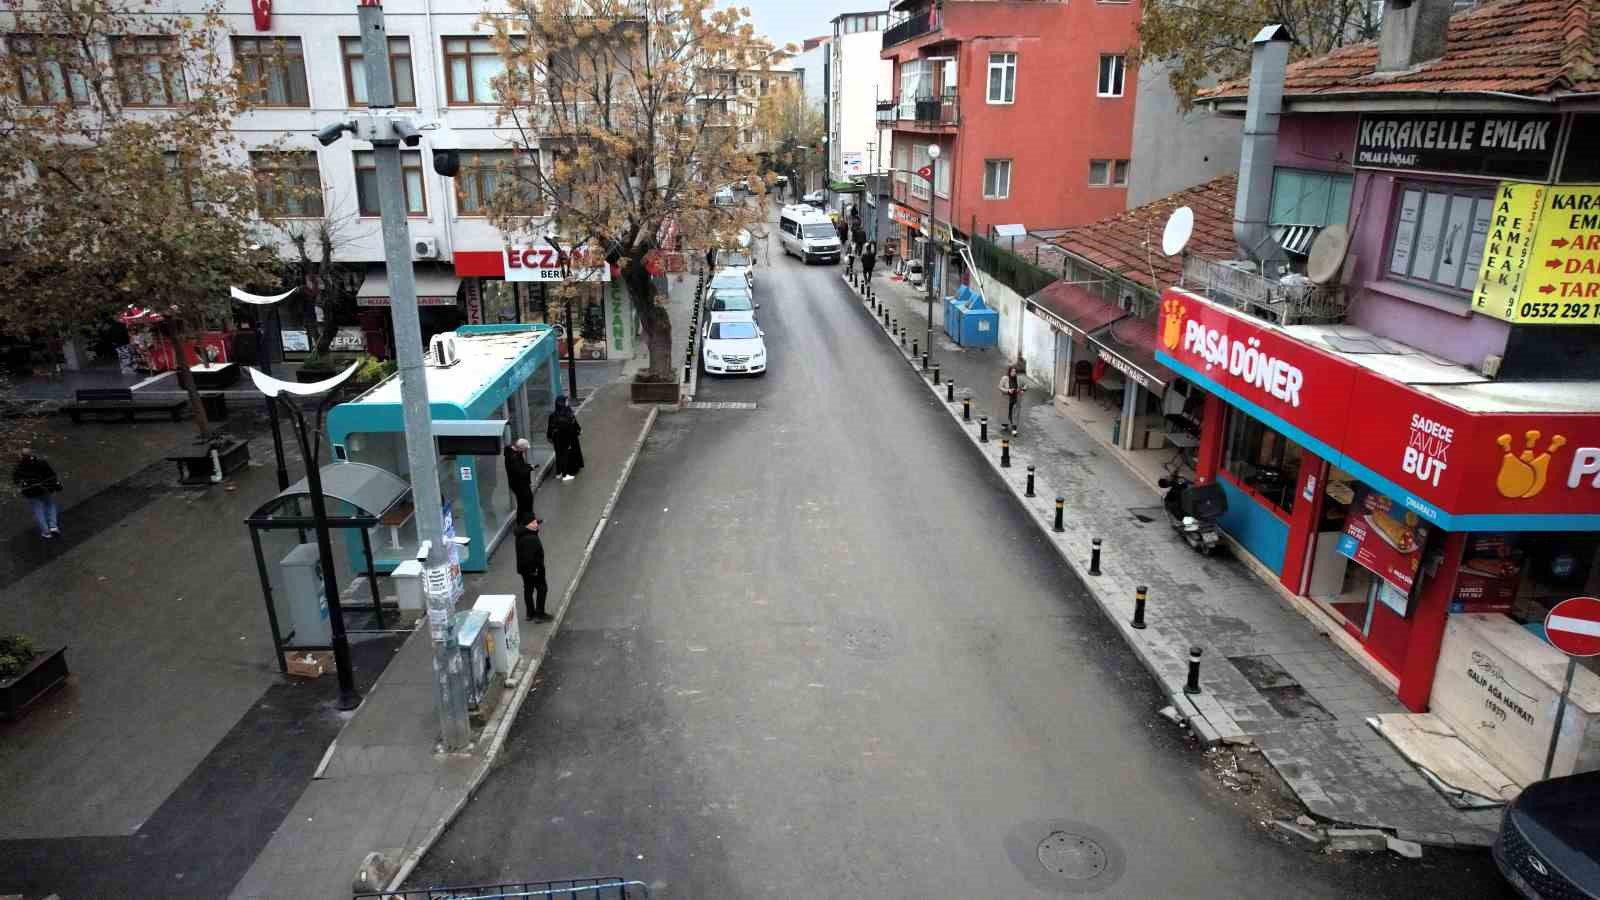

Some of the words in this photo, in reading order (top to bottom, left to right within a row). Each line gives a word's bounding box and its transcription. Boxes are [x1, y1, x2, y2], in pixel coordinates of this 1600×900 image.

[1360, 119, 1476, 150] KARAKELLE
[1480, 119, 1550, 151] EMLAK
[1478, 188, 1513, 308] KARAKELLE
[1498, 217, 1522, 286] EMLAK
[1521, 302, 1559, 318] 0532
[1561, 303, 1590, 318] 292
[1184, 319, 1229, 371] PAŞA
[1229, 336, 1304, 408] DÖNER
[1409, 428, 1450, 463] TAVUK
[1410, 413, 1454, 443] SADECE
[1402, 447, 1447, 488] BUT
